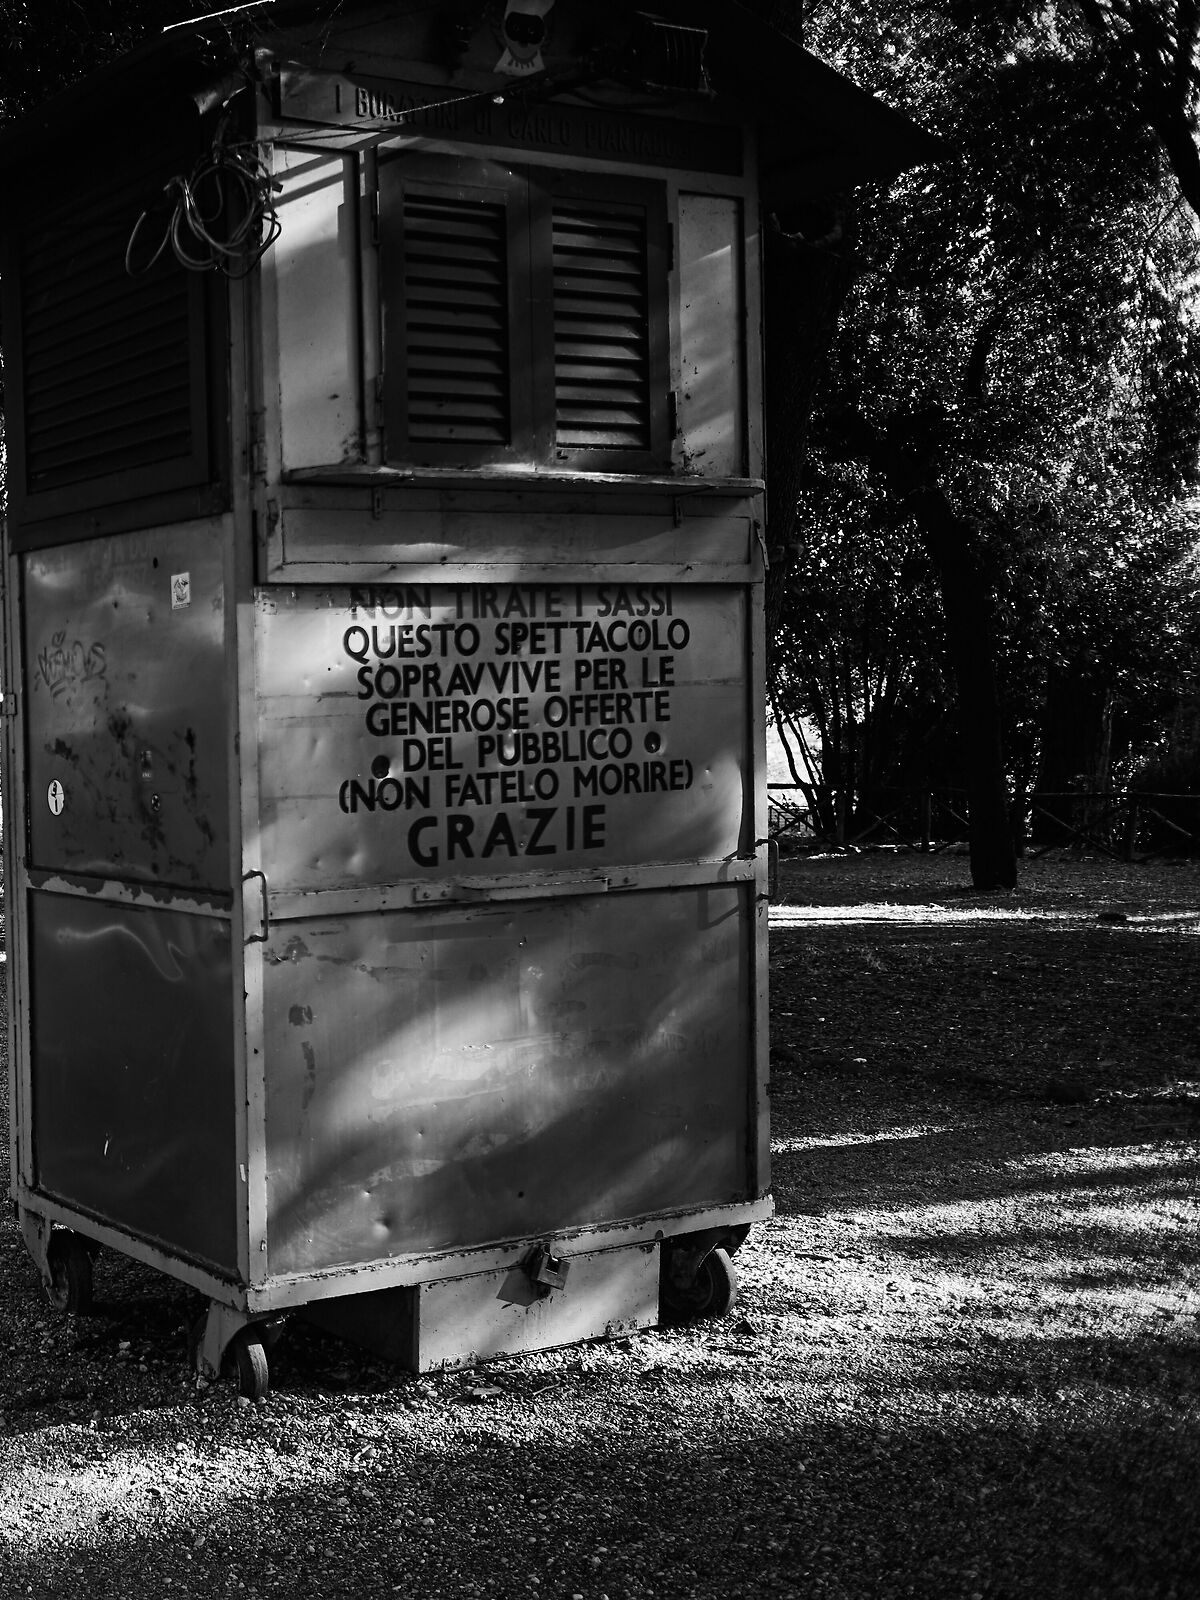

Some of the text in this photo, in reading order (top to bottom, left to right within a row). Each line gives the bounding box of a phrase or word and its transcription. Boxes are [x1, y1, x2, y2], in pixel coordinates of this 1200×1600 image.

[335, 84, 341, 113] I
[356, 87, 459, 130] BURATTINI
[474, 105, 493, 135] DI
[507, 111, 572, 146] CARLO
[351, 583, 673, 619] NON TIRATE I SASSI
[343, 619, 690, 664] QUESTO SPETTACOLO
[357, 656, 675, 700] SOPRAVVIVE PER LE
[365, 691, 670, 736] GENEROSE OFFERTE
[403, 728, 632, 772] DEL PUBBLICO
[339, 760, 693, 814] (NON FATELO MORIRE)
[407, 805, 606, 868] GRAZIE
